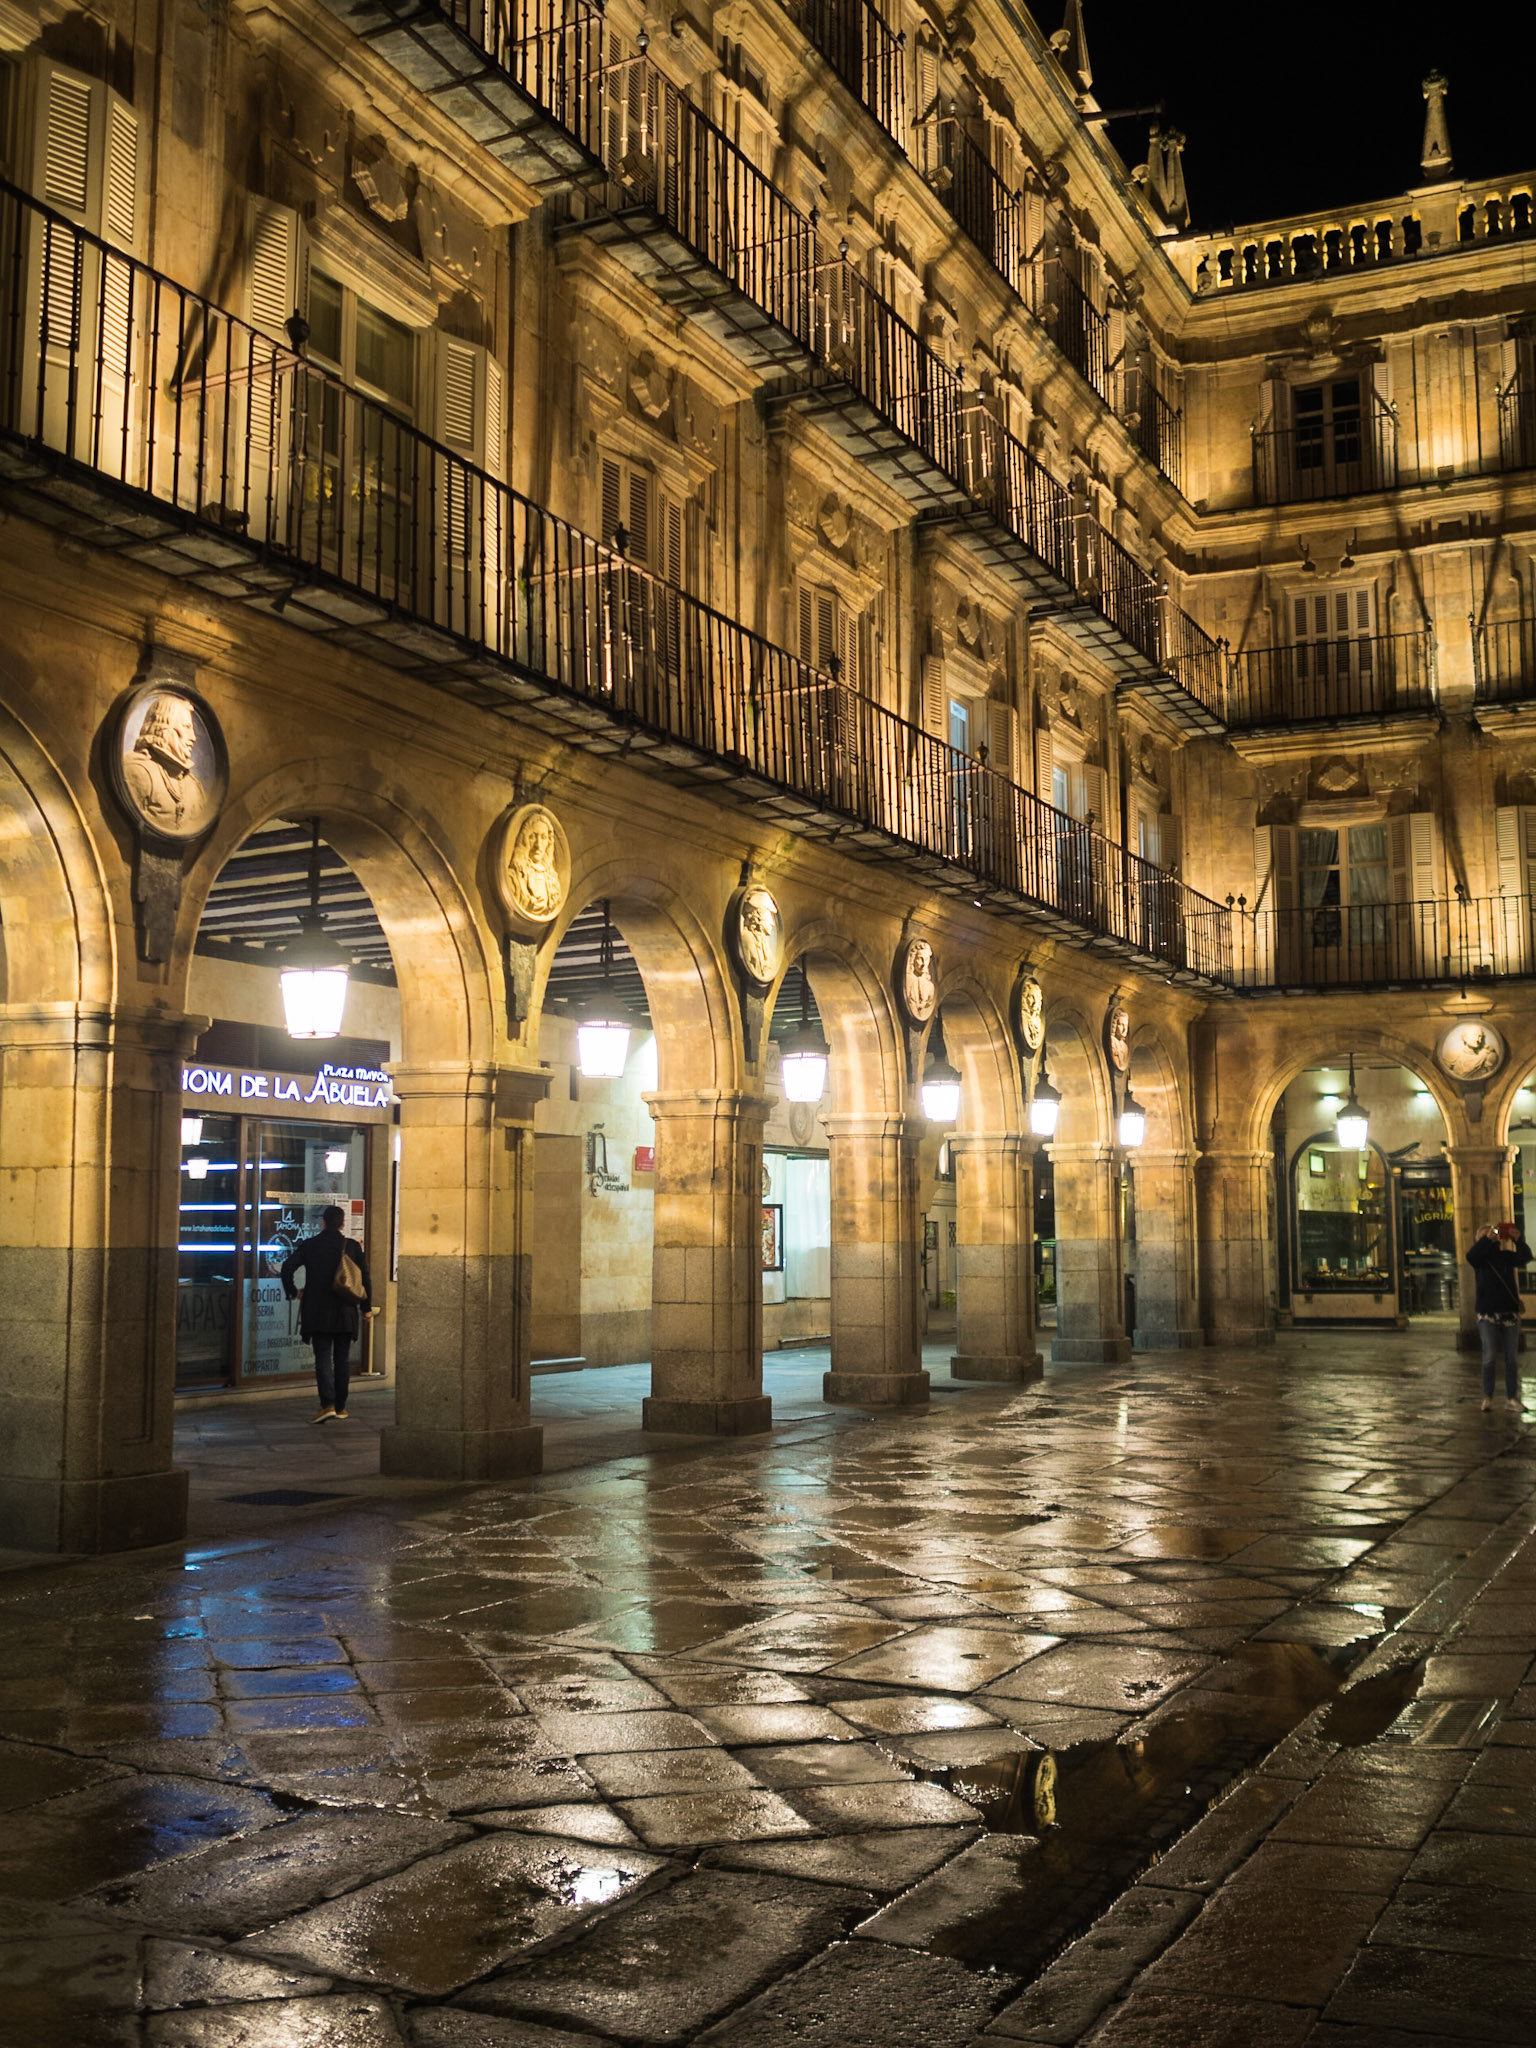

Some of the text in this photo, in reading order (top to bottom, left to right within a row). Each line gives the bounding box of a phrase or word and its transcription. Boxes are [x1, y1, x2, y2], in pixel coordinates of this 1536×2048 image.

[323, 1063, 354, 1079] PLAZA
[240, 1074, 268, 1098] DE
[274, 1076, 301, 1101] LA
[251, 1284, 281, 1303] cocina
